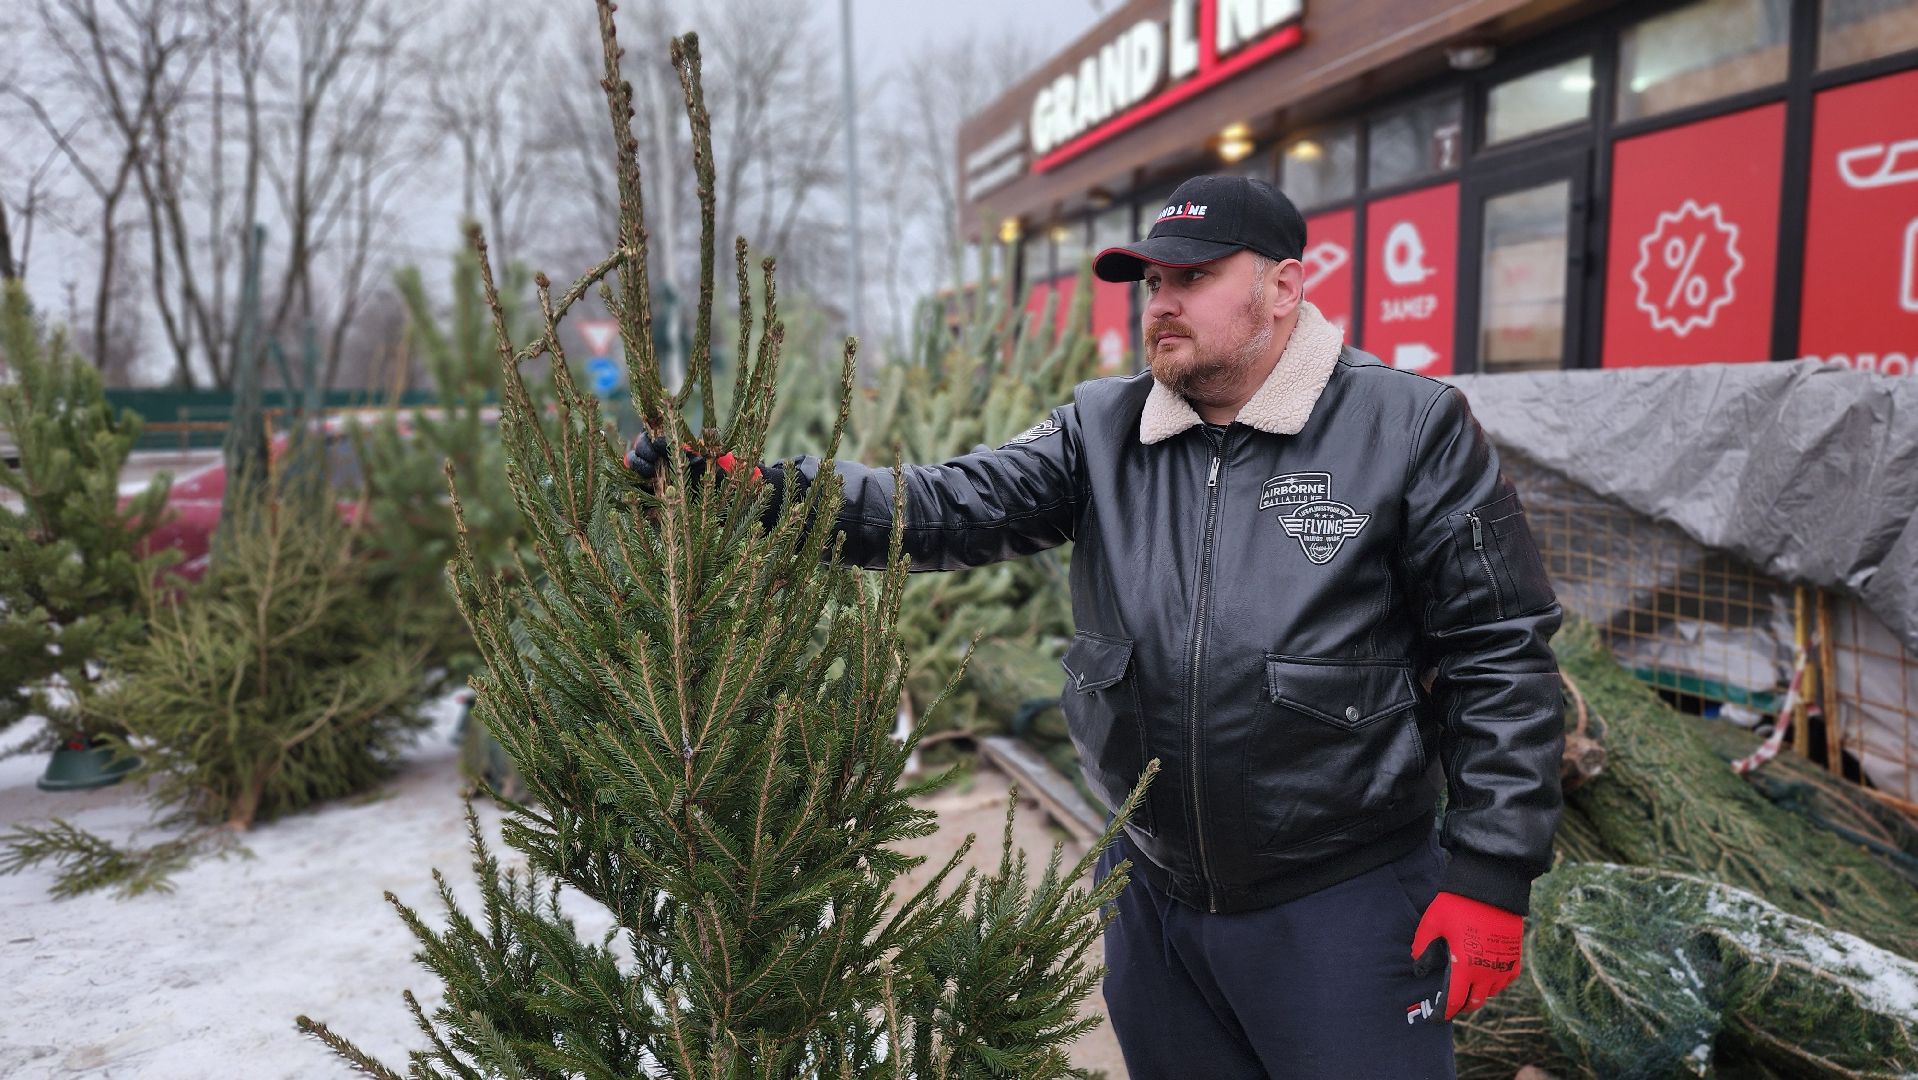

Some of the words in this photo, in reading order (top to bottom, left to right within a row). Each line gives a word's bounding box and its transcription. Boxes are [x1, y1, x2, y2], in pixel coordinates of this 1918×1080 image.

[1030, 19, 1163, 155] GRAND
[1176, 200, 1208, 216] LINE
[1380, 294, 1438, 323] ЗАМЕР
[1263, 484, 1326, 500] AIRBORNE
[1303, 519, 1343, 535] FLYING
